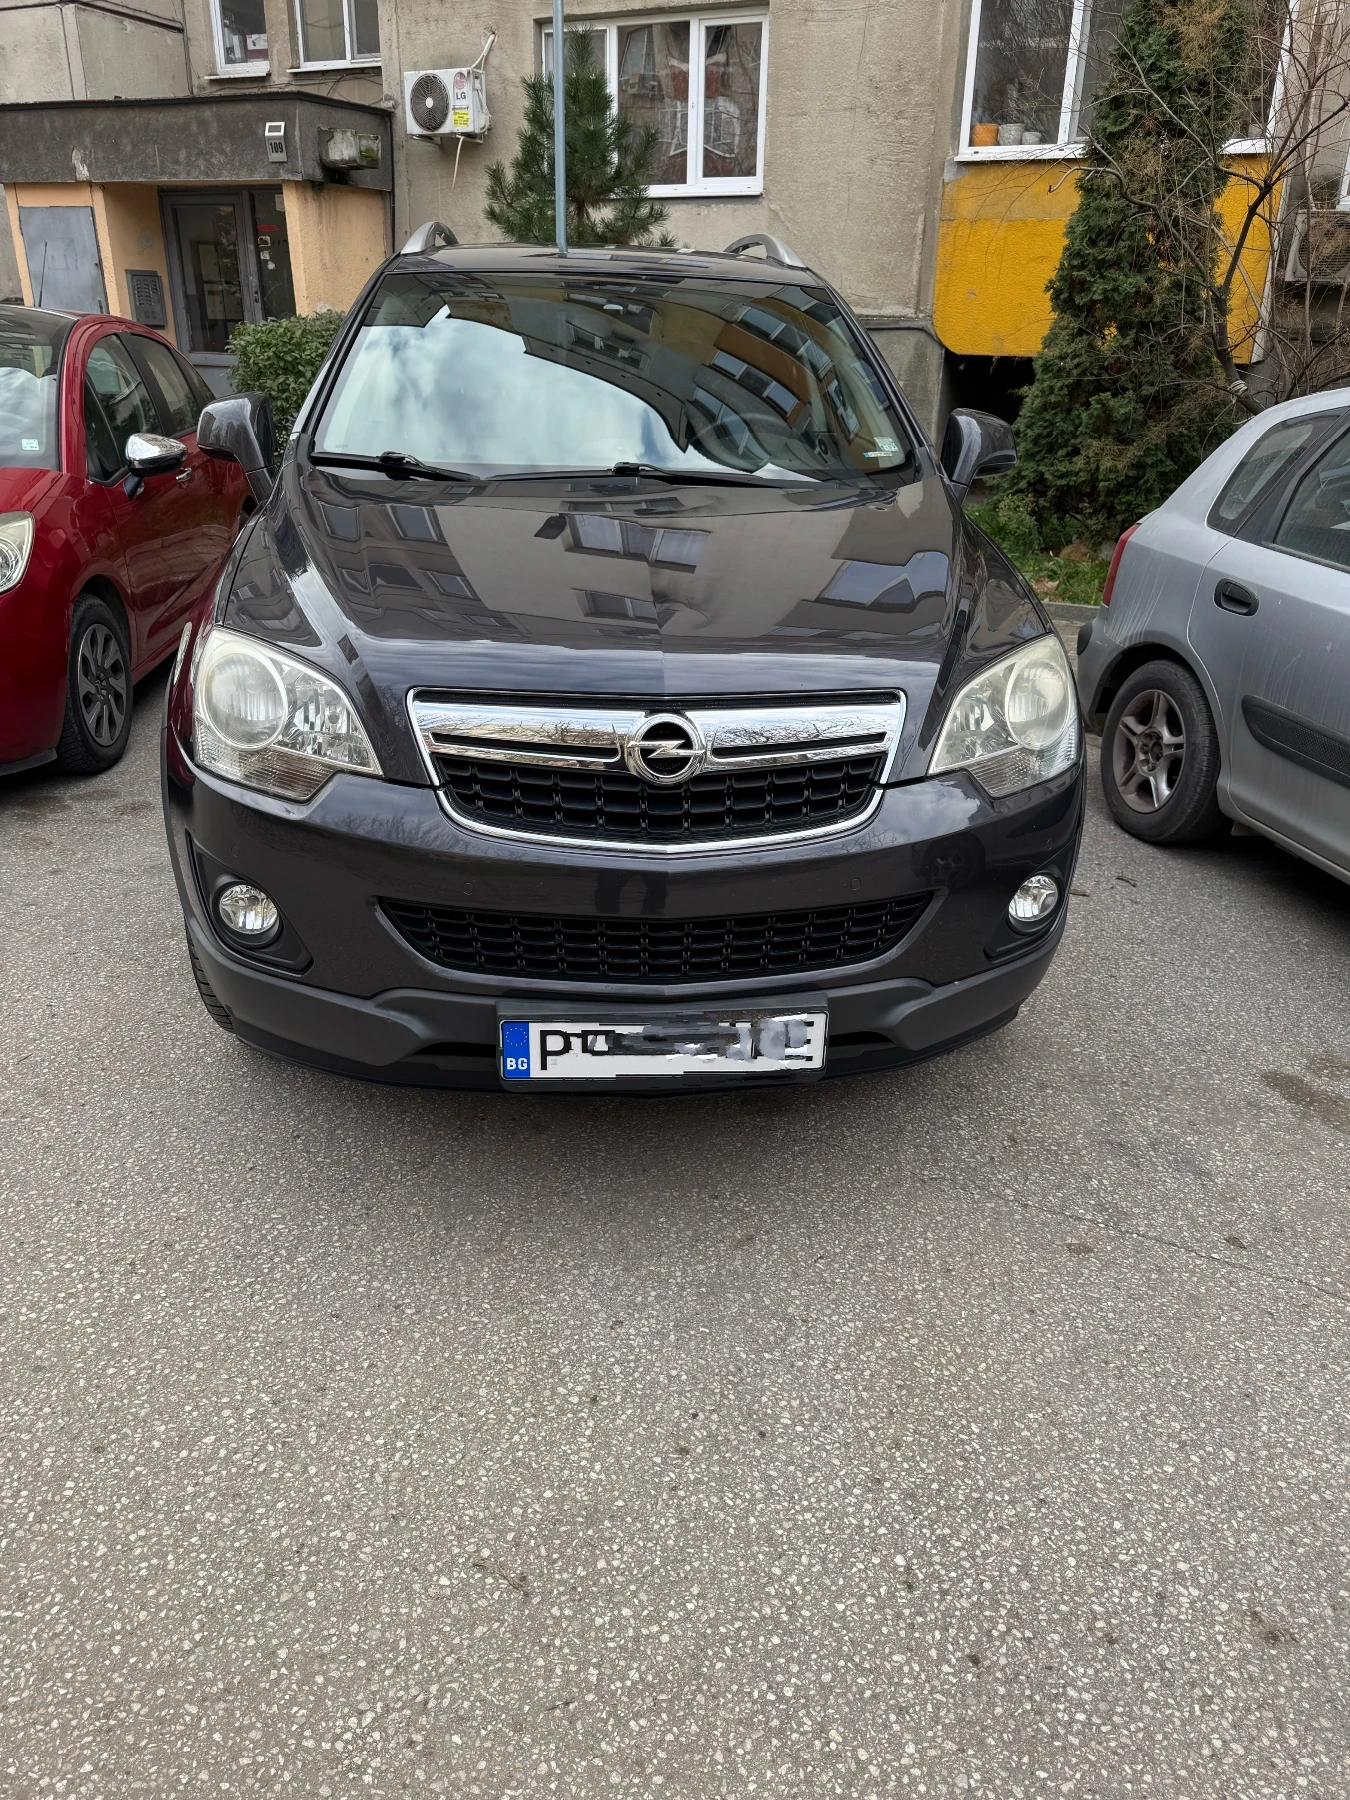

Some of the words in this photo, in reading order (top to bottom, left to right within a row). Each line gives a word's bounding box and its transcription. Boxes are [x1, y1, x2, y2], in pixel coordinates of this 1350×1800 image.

[455, 91, 467, 100] LG
[270, 141, 284, 154] 109
[506, 1057, 528, 1070] BG
